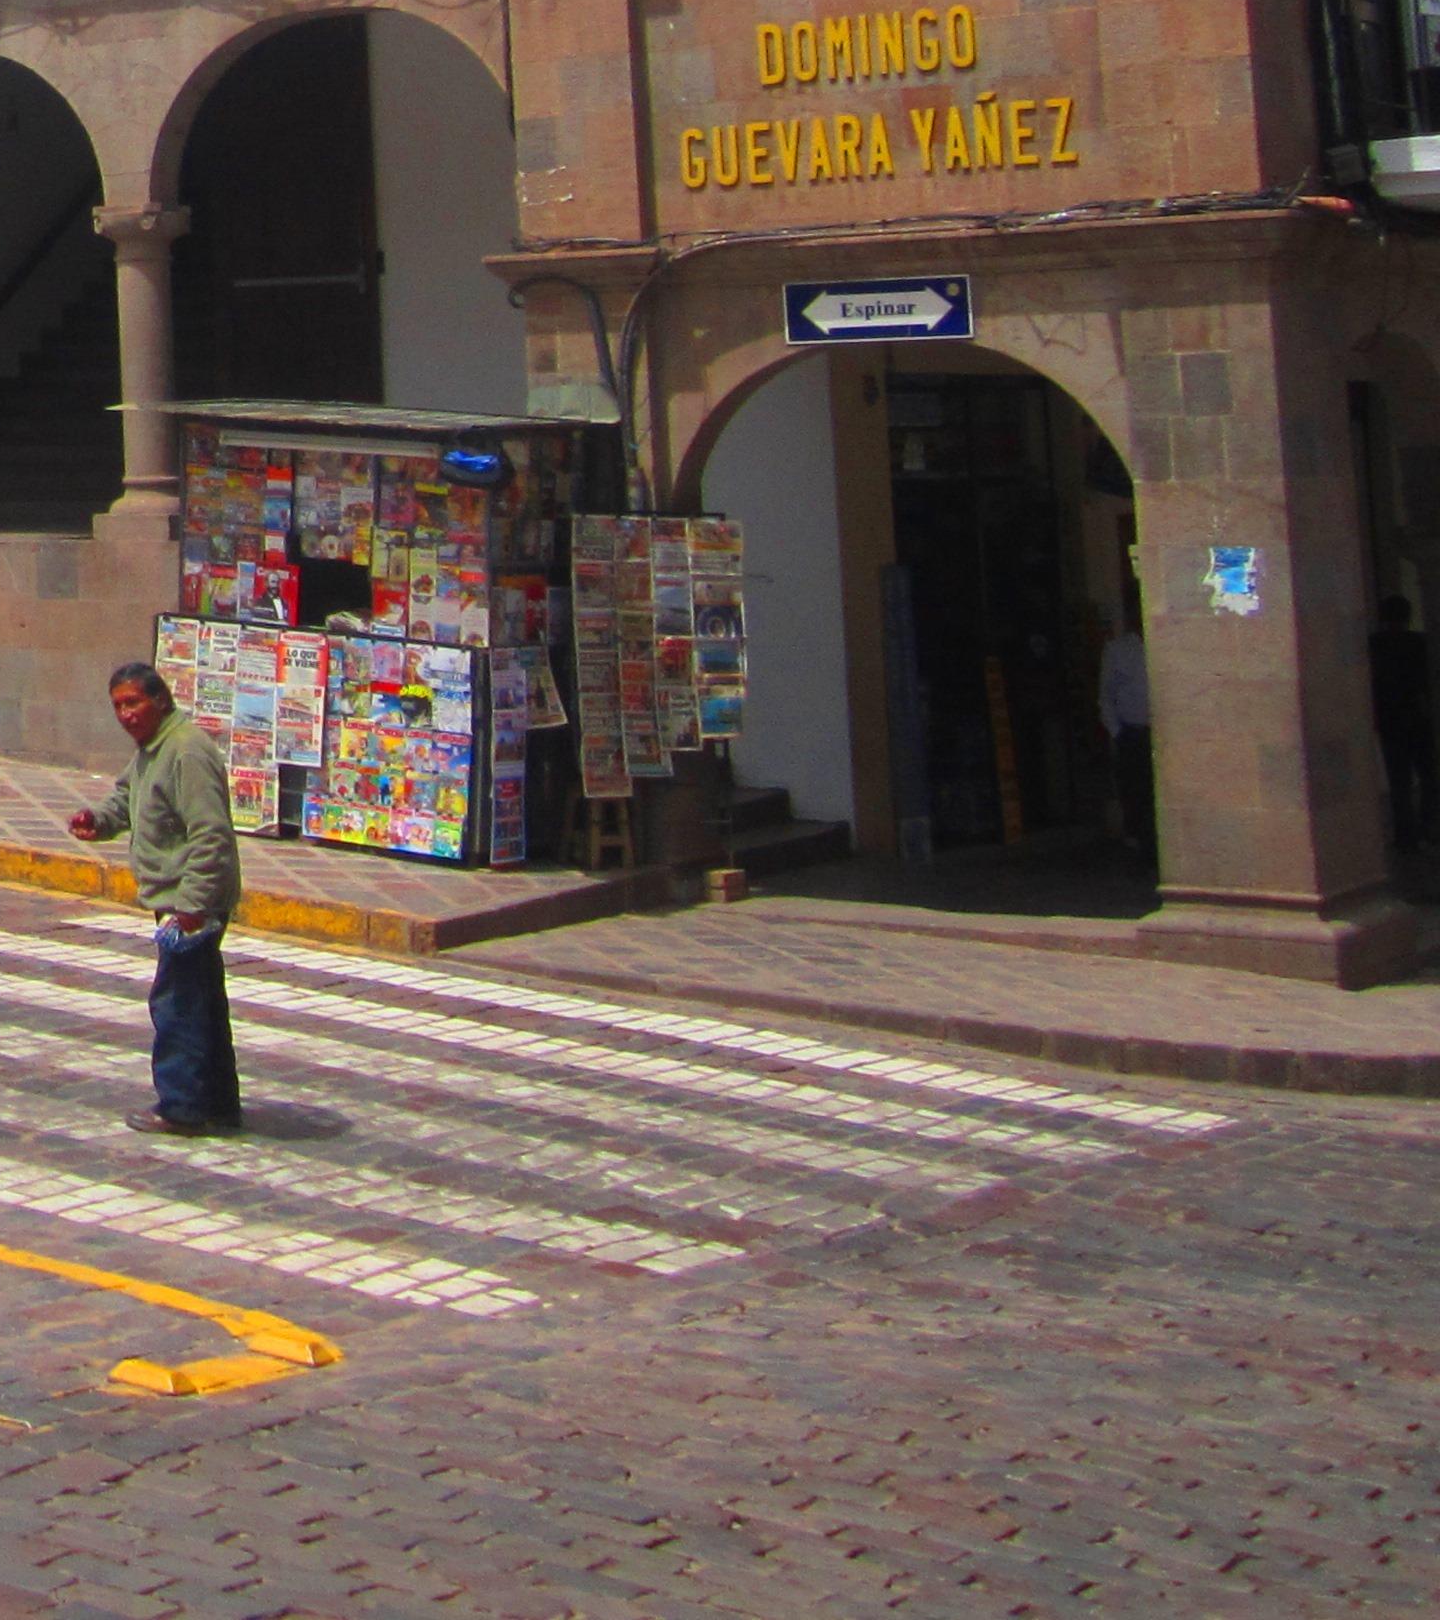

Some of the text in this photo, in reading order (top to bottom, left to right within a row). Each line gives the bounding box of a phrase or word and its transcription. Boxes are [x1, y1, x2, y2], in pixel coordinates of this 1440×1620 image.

[755, 4, 978, 86] DOMINGO
[680, 92, 1080, 188] GUEVARA YAÑEZ
[840, 300, 917, 320] Espinar
[286, 648, 298, 658] LO
